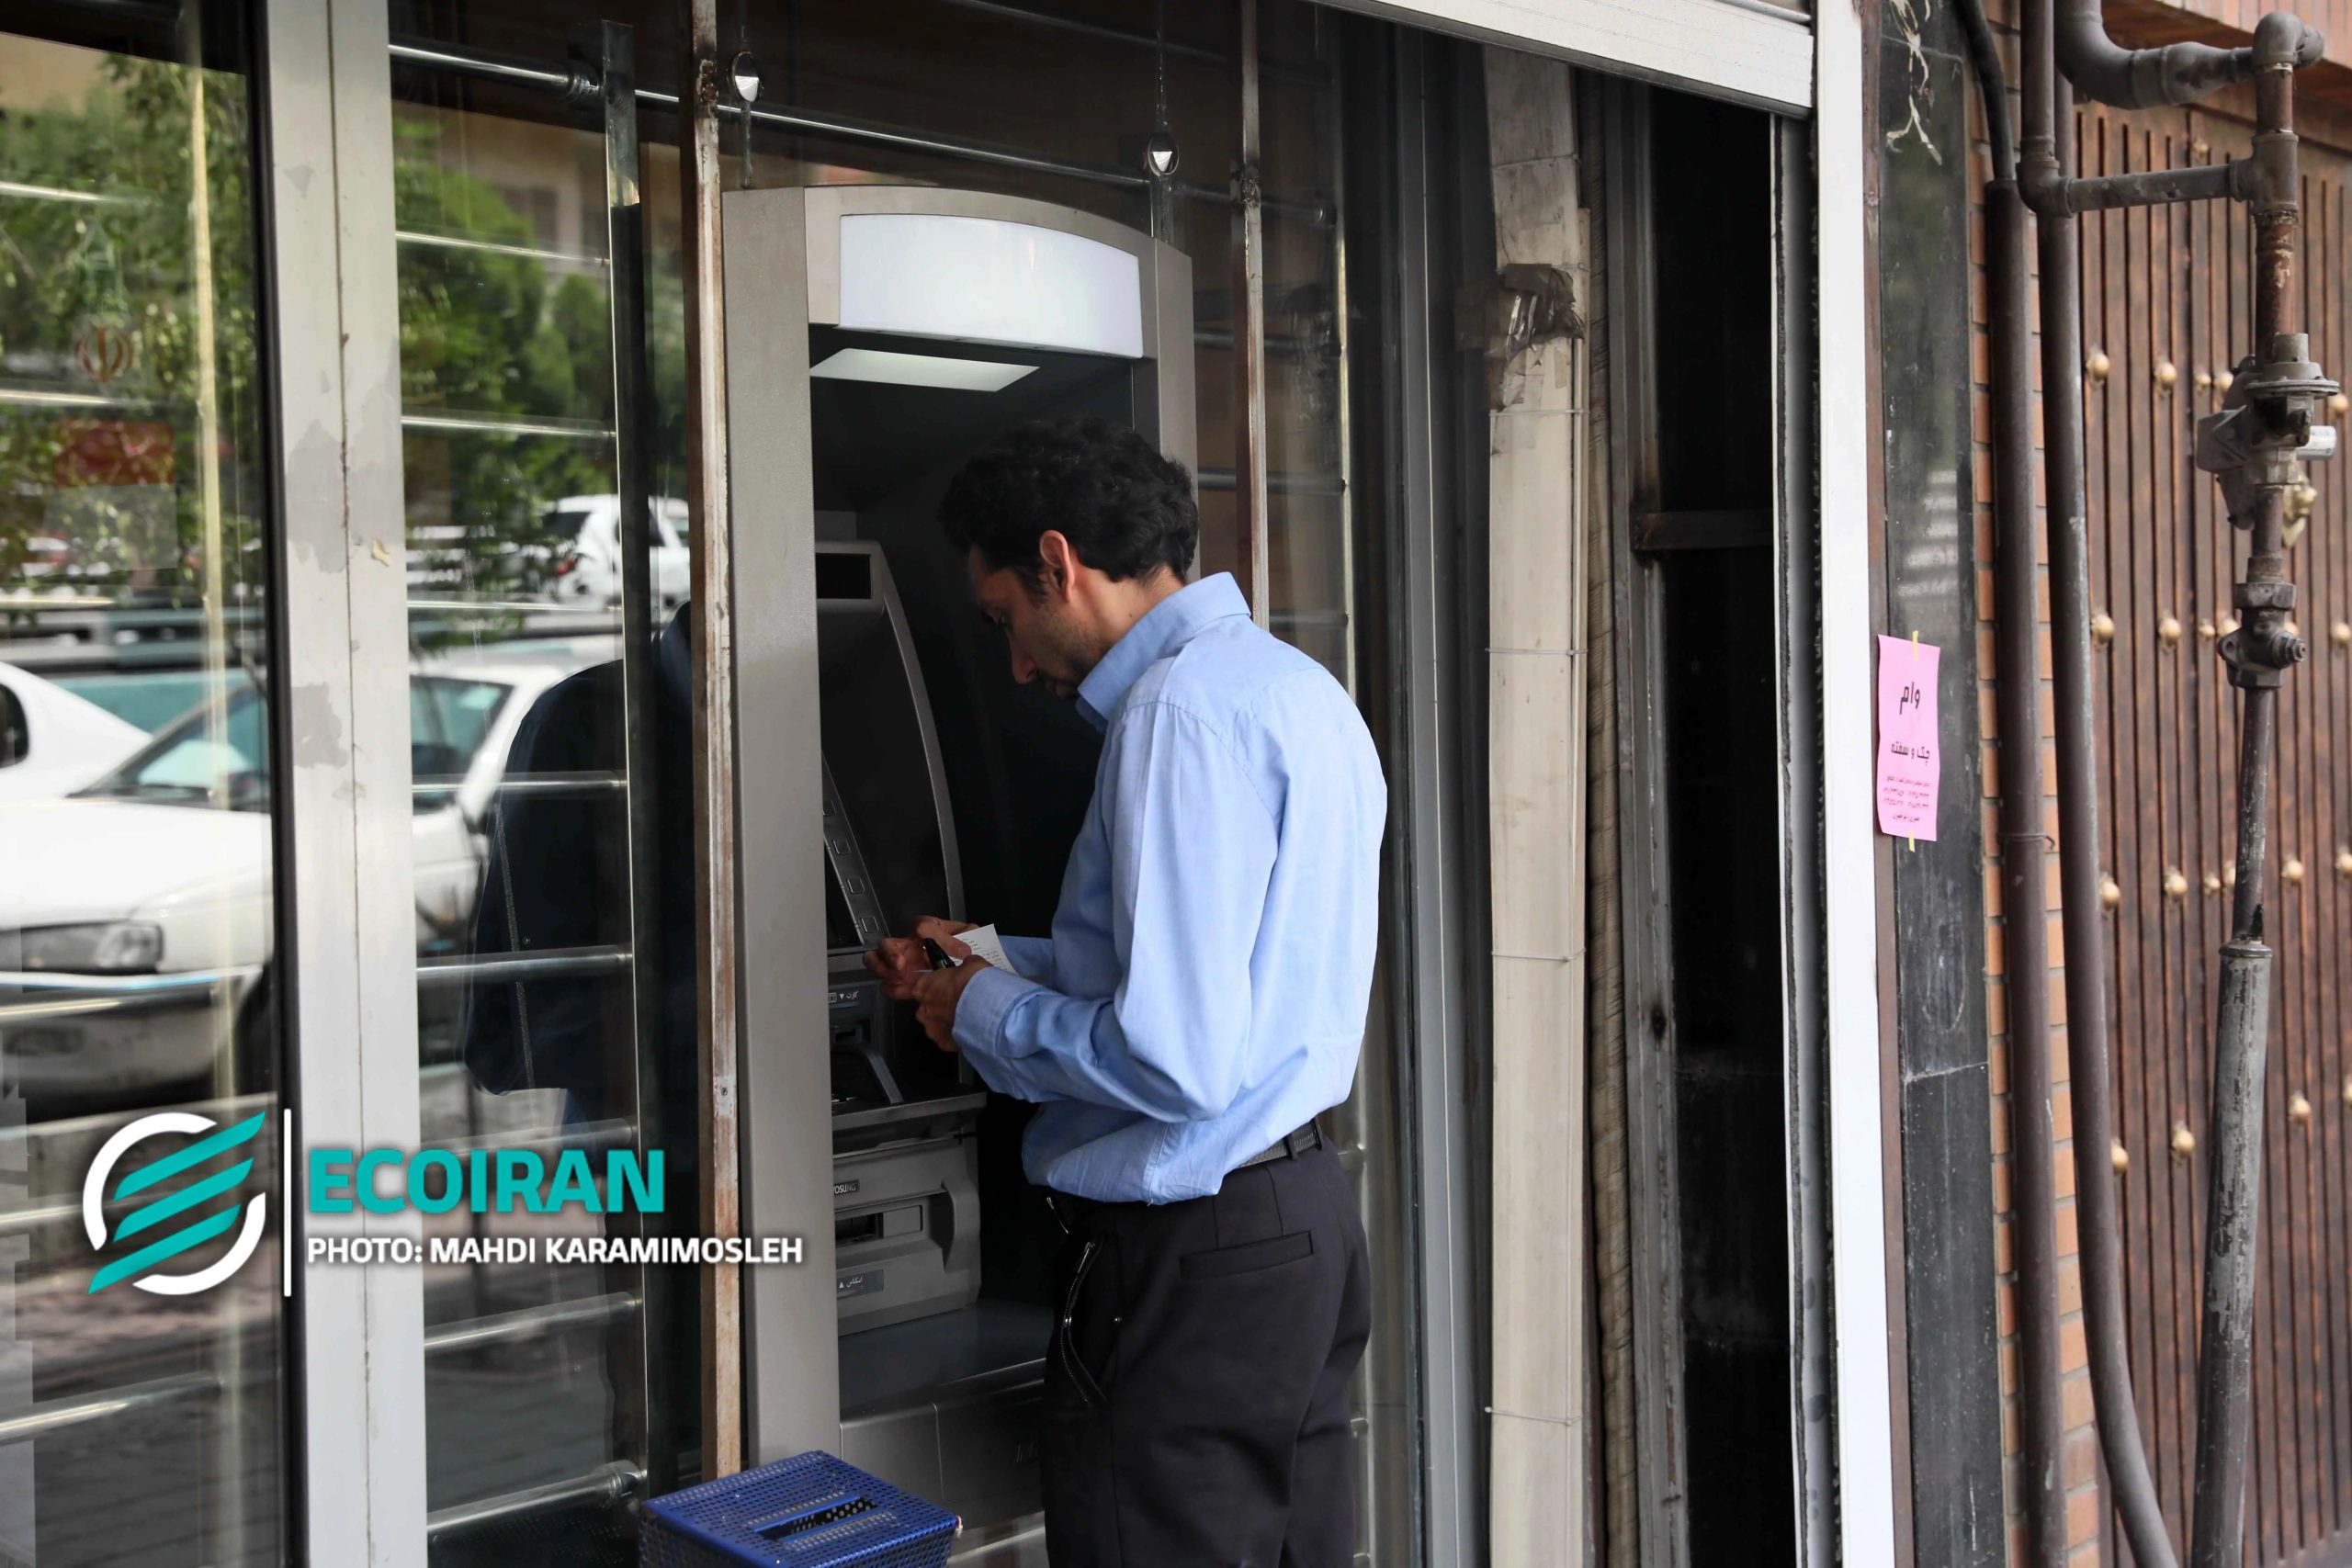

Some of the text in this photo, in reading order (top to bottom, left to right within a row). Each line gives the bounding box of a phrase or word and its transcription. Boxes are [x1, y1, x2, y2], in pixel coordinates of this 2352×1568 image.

[1899, 682, 1921, 715] وام
[1891, 740, 1930, 766] چک و سفته
